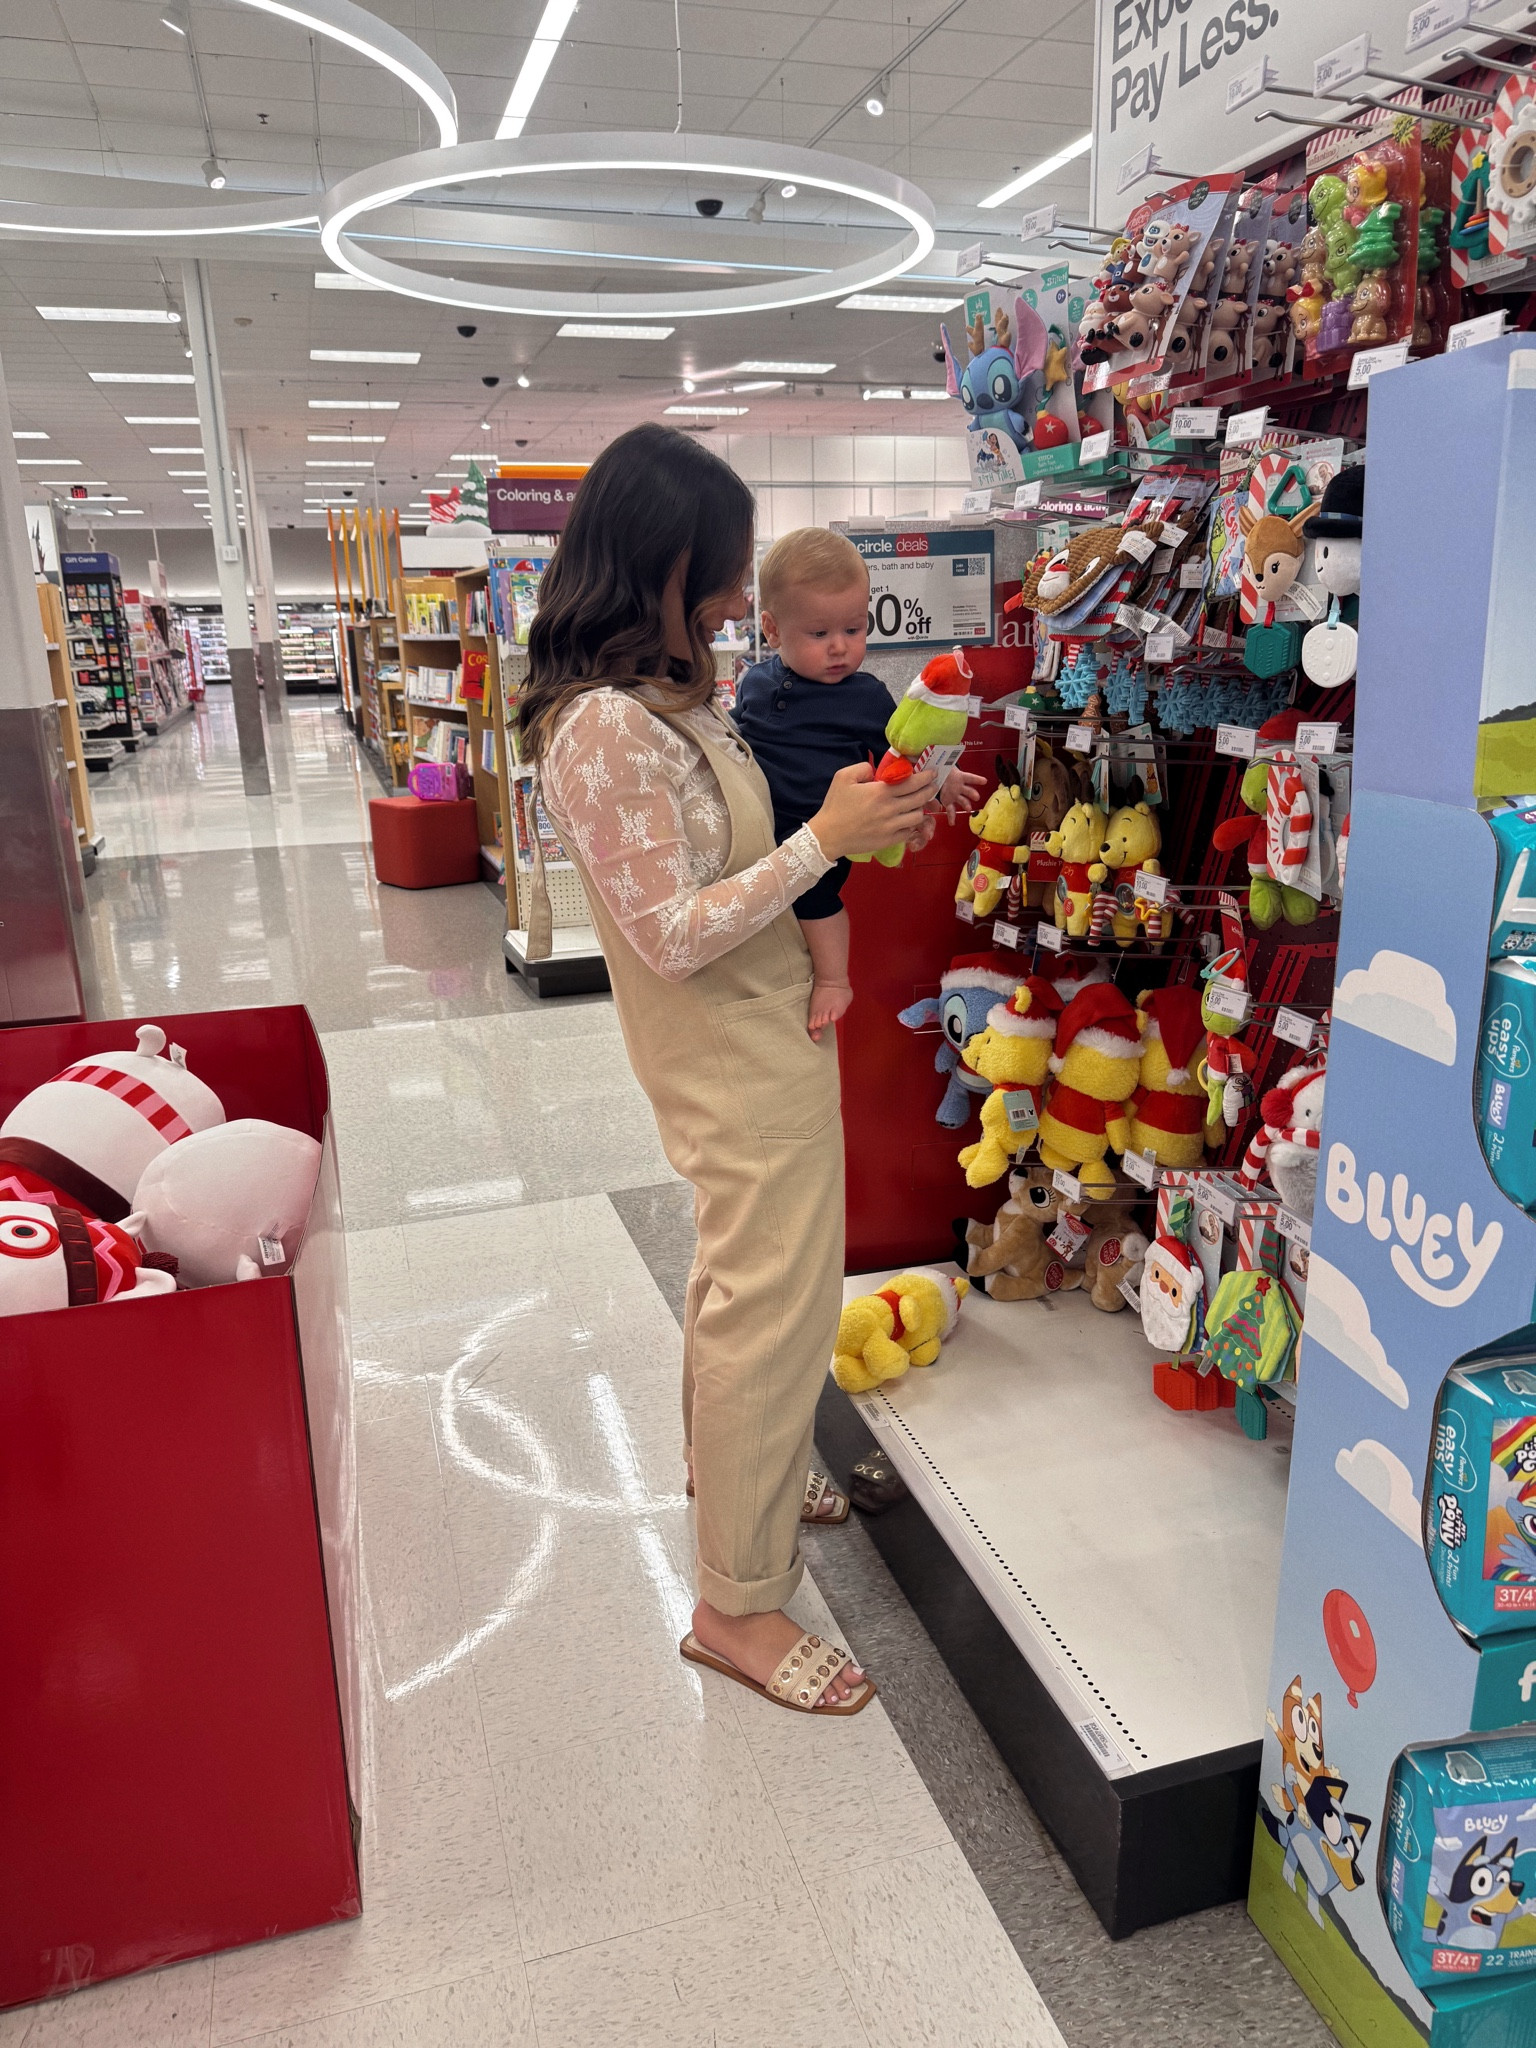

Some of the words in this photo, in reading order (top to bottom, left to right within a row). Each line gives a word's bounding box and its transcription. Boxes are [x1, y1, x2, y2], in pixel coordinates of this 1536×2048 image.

[1412, 16, 1431, 35] 5.00
[1111, 51, 1170, 133] Pay
[1179, 0, 1279, 89] Less.
[1316, 66, 1333, 84] 5.00
[1356, 364, 1371, 375] 5.00
[1175, 420, 1192, 429] 10.00
[497, 488, 551, 504] Coloring
[553, 488, 564, 502] &
[896, 537, 929, 552] deals
[881, 562, 899, 571] bath
[900, 561, 914, 570] and
[915, 560, 935, 571] baby
[870, 585, 884, 595] get
[903, 598, 924, 619] %
[905, 616, 931, 635] off
[1218, 735, 1230, 746] 5.00
[1300, 735, 1312, 746] 5.00
[1036, 859, 1057, 867] Plushie
[1278, 1020, 1289, 1031] 5.00
[1487, 1018, 1501, 1056] ups
[1499, 1018, 1512, 1066] easy
[1489, 1083, 1506, 1126] BLUEY
[1197, 1188, 1209, 1201] 5.00
[1280, 1217, 1293, 1231] 5.00
[1325, 1141, 1504, 1308] BLUEY
[1443, 1425, 1457, 1476] easy
[1438, 1493, 1459, 1549] PONY
[1499, 1588, 1536, 1603] 3T/4
[1464, 1813, 1508, 1835] BLUEY
[1437, 1951, 1479, 1967] 3T/4T
[1485, 1954, 1505, 1967] 22
